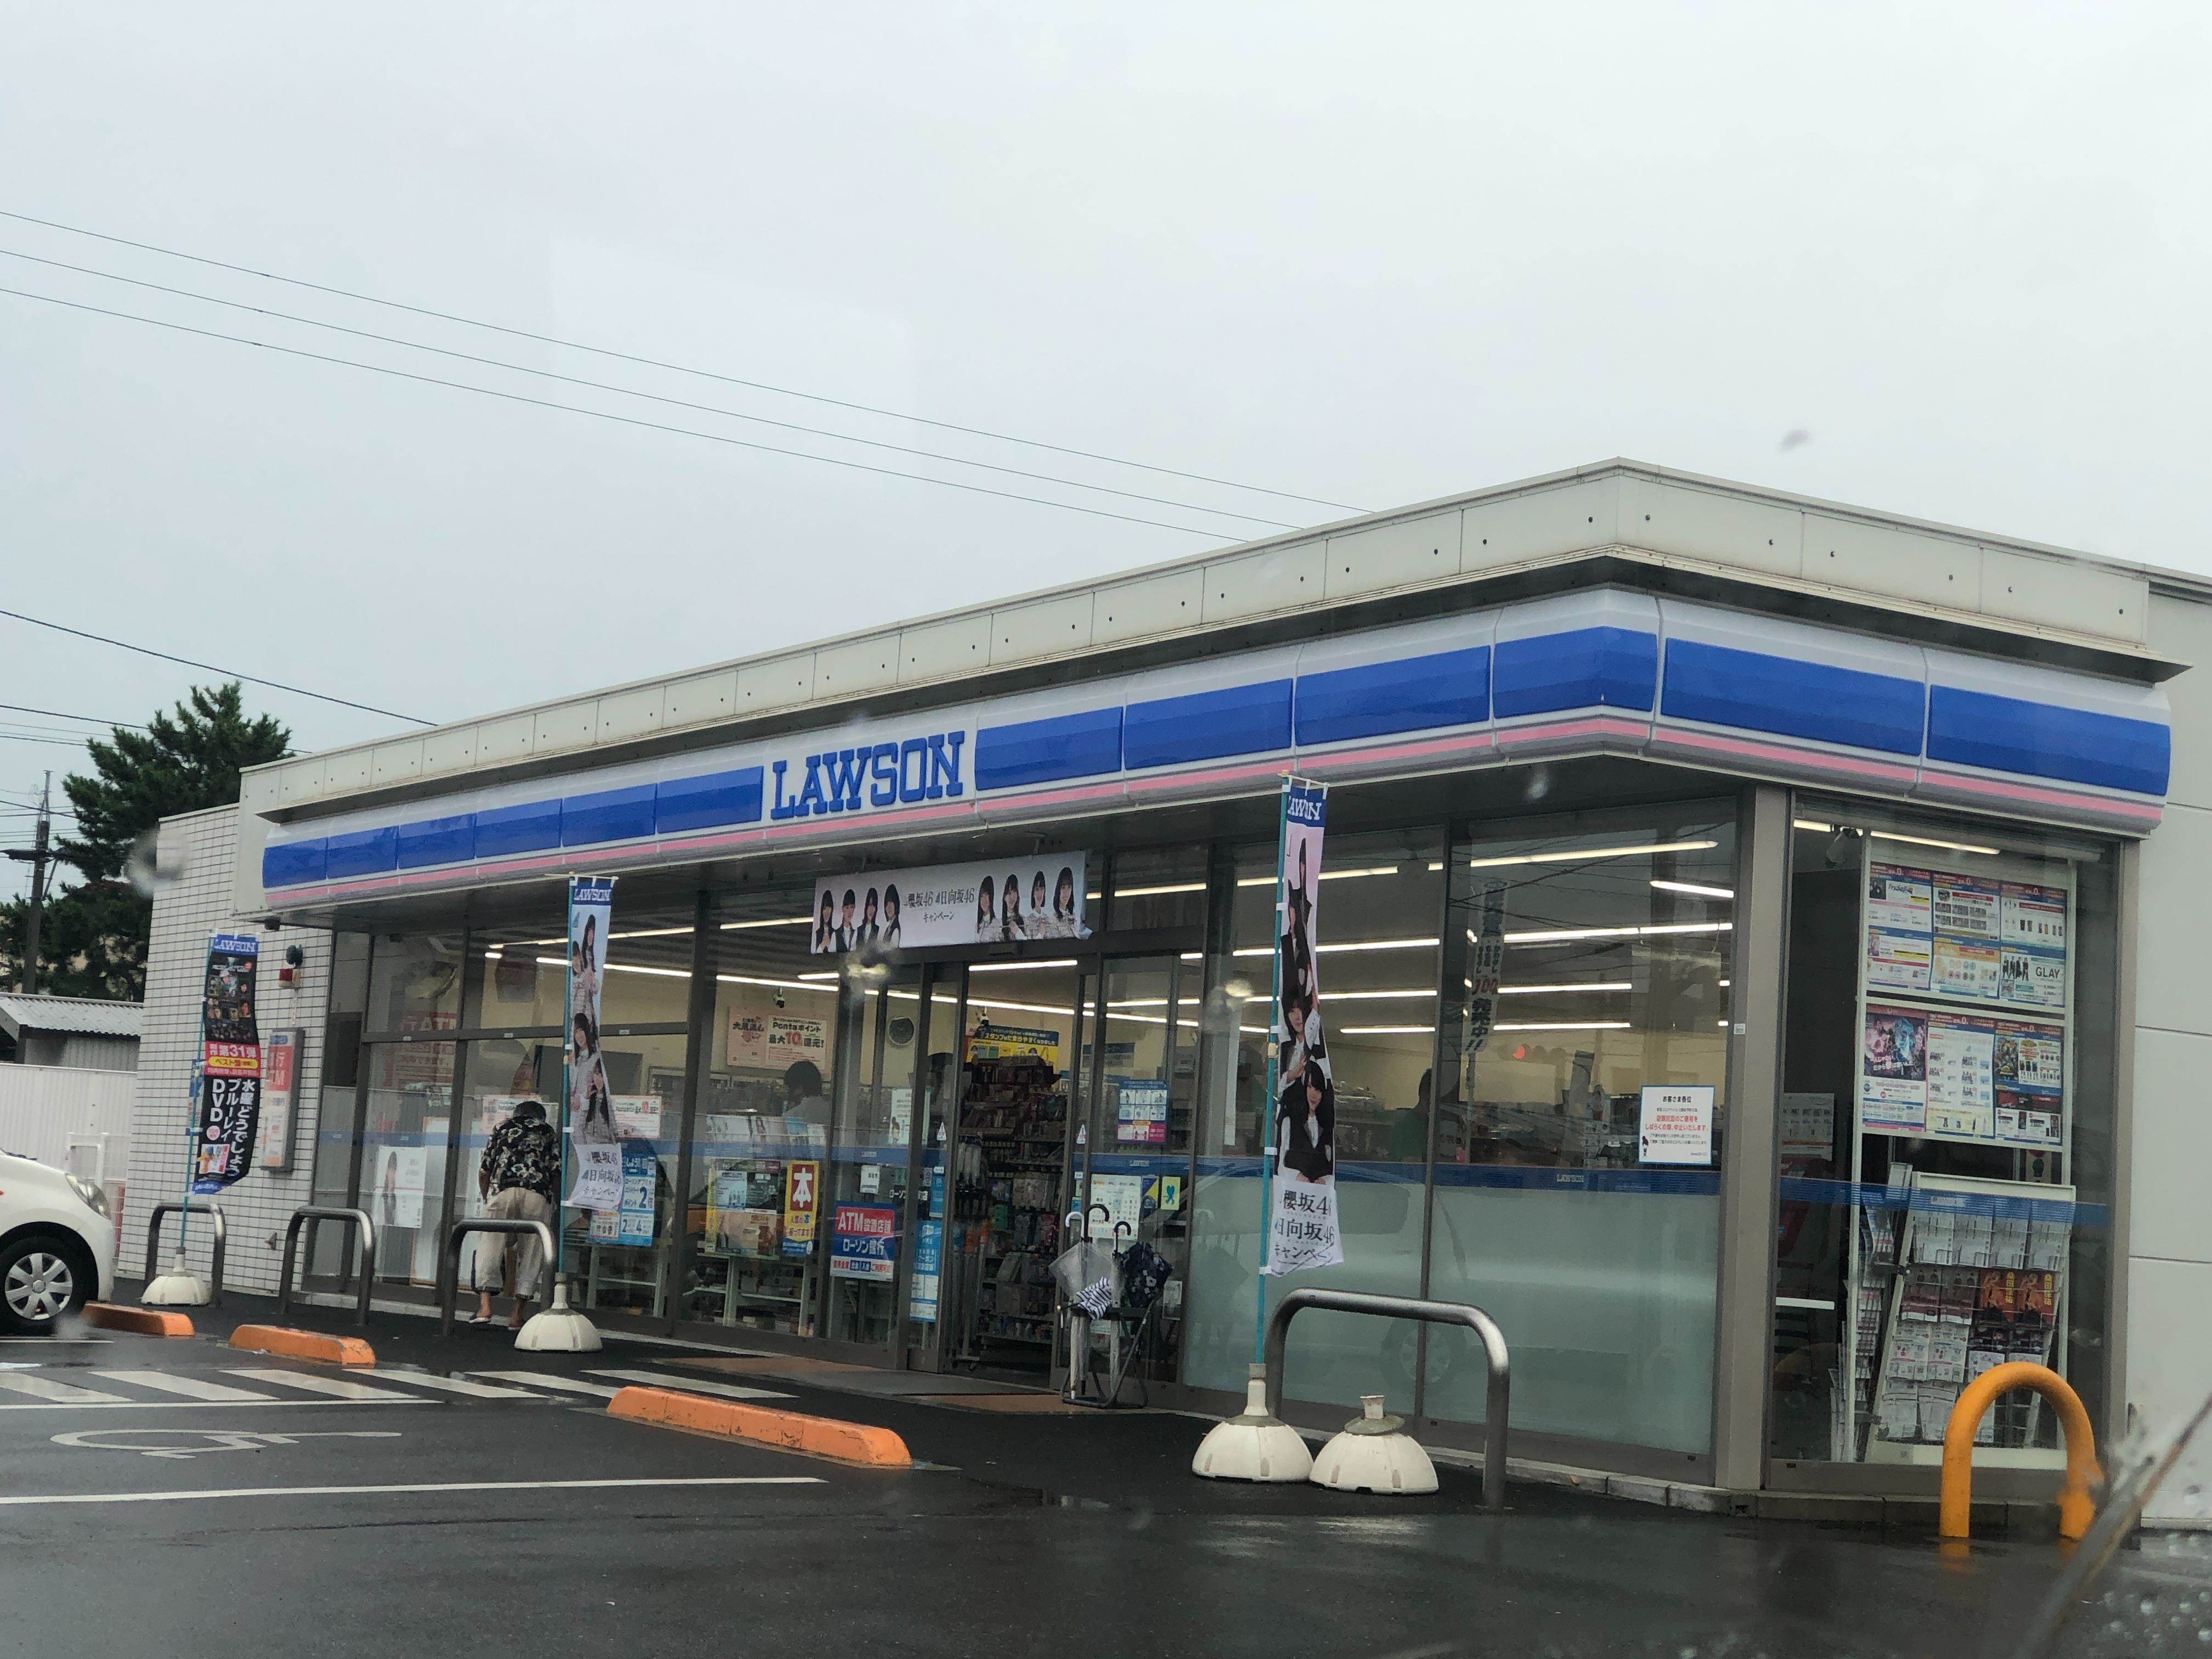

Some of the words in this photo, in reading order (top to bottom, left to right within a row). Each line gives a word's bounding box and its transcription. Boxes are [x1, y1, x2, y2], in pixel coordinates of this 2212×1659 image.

[770, 730, 965, 820] LAWSON
[1288, 795, 1322, 820] AWN
[574, 888, 612, 901] LAWSON
[908, 891, 933, 909] 櫻坂46
[941, 887, 975, 905] 日向坂46
[923, 911, 954, 923] キャンペーン
[2035, 966, 2060, 978] GLAY
[210, 1079, 226, 1122] DVD
[221, 1079, 242, 1142] ブルーレイ
[1556, 1174, 1585, 1182] LAWSON
[584, 1186, 619, 1196] キャンペー
[1283, 1189, 1332, 1216] 櫻坂4
[838, 1212, 891, 1234] ATM設置店舗
[843, 1238, 885, 1255] ローソン銀行
